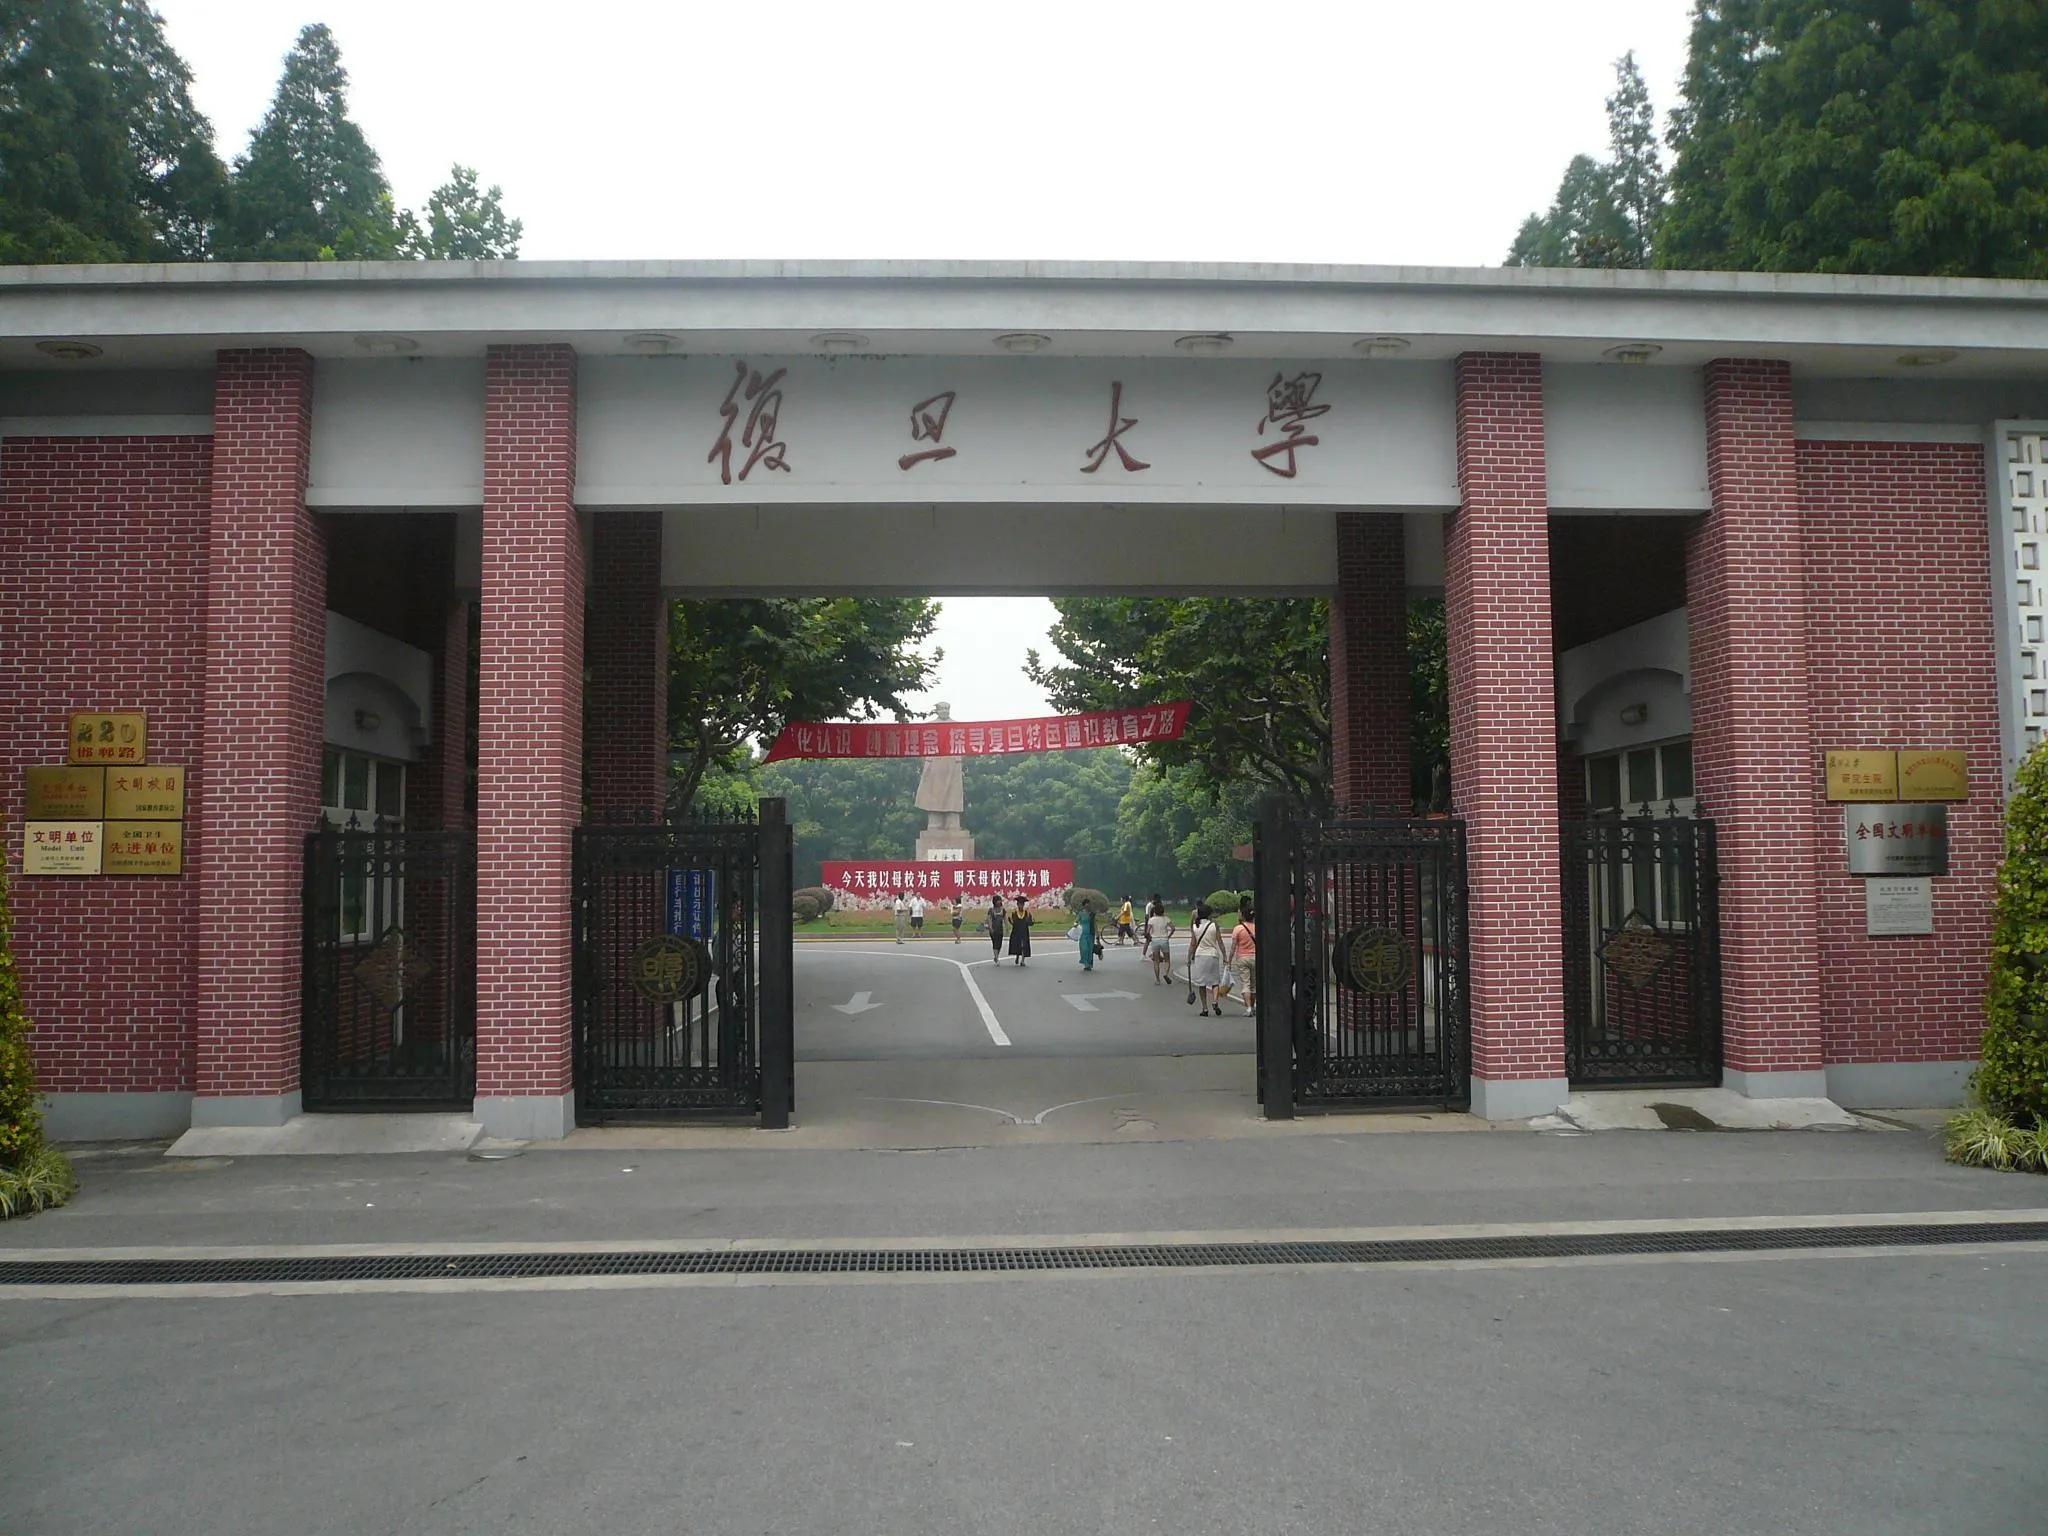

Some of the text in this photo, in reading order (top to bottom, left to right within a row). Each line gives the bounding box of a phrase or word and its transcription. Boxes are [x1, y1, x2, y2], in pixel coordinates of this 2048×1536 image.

[77, 720, 137, 743] 220
[790, 727, 851, 752] 化认识
[78, 746, 136, 759] 邯郸路
[113, 776, 176, 791] 文明校园
[33, 830, 94, 844] 文明单位
[110, 841, 176, 855] 先进单位
[841, 869, 1050, 889] 今天我以母校为荣 明天母校以我为傲
